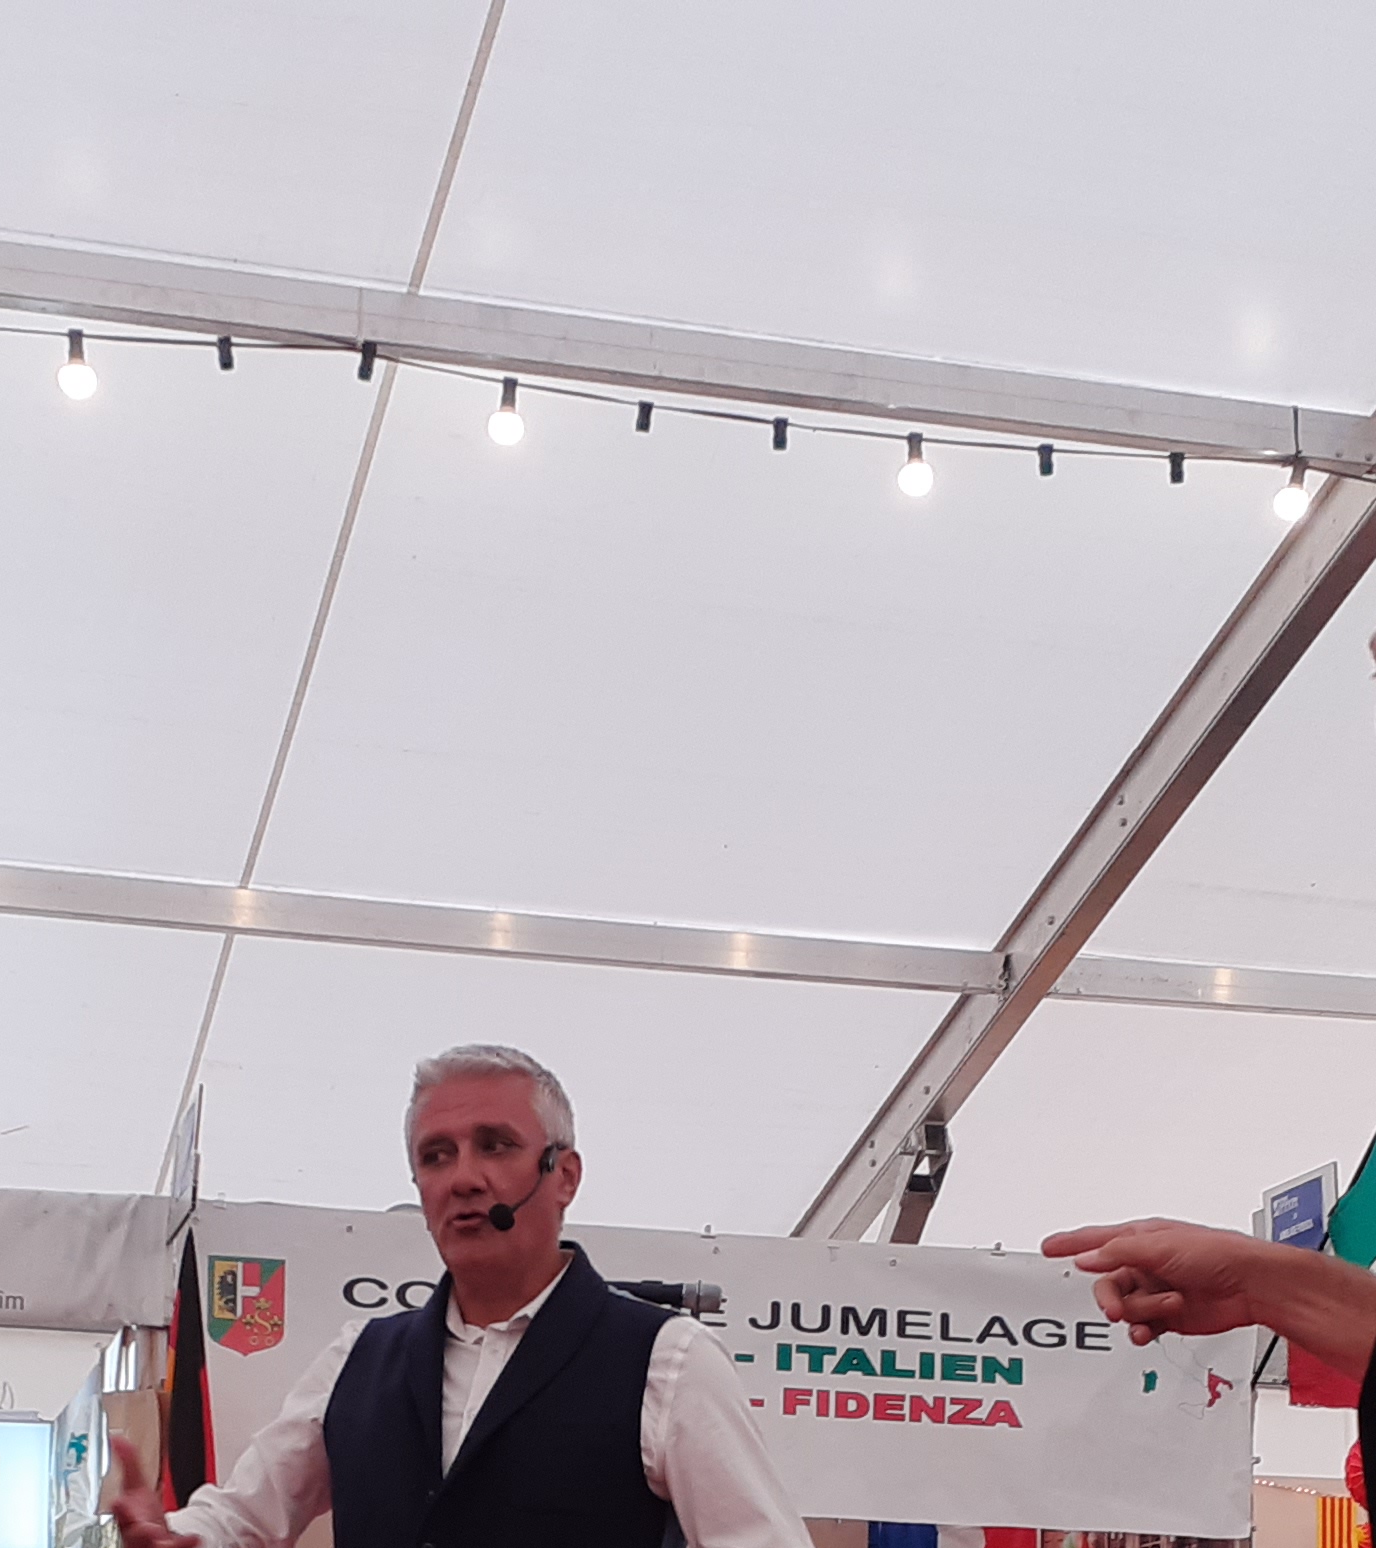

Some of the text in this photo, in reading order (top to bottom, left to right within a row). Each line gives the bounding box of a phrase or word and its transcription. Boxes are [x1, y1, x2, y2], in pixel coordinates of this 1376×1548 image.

[342, 1277, 438, 1310] CO
[748, 1300, 1113, 1352] JUMELAGE
[776, 1342, 1024, 1386] ITALIEN
[782, 1387, 1024, 1429] FIDENZA
